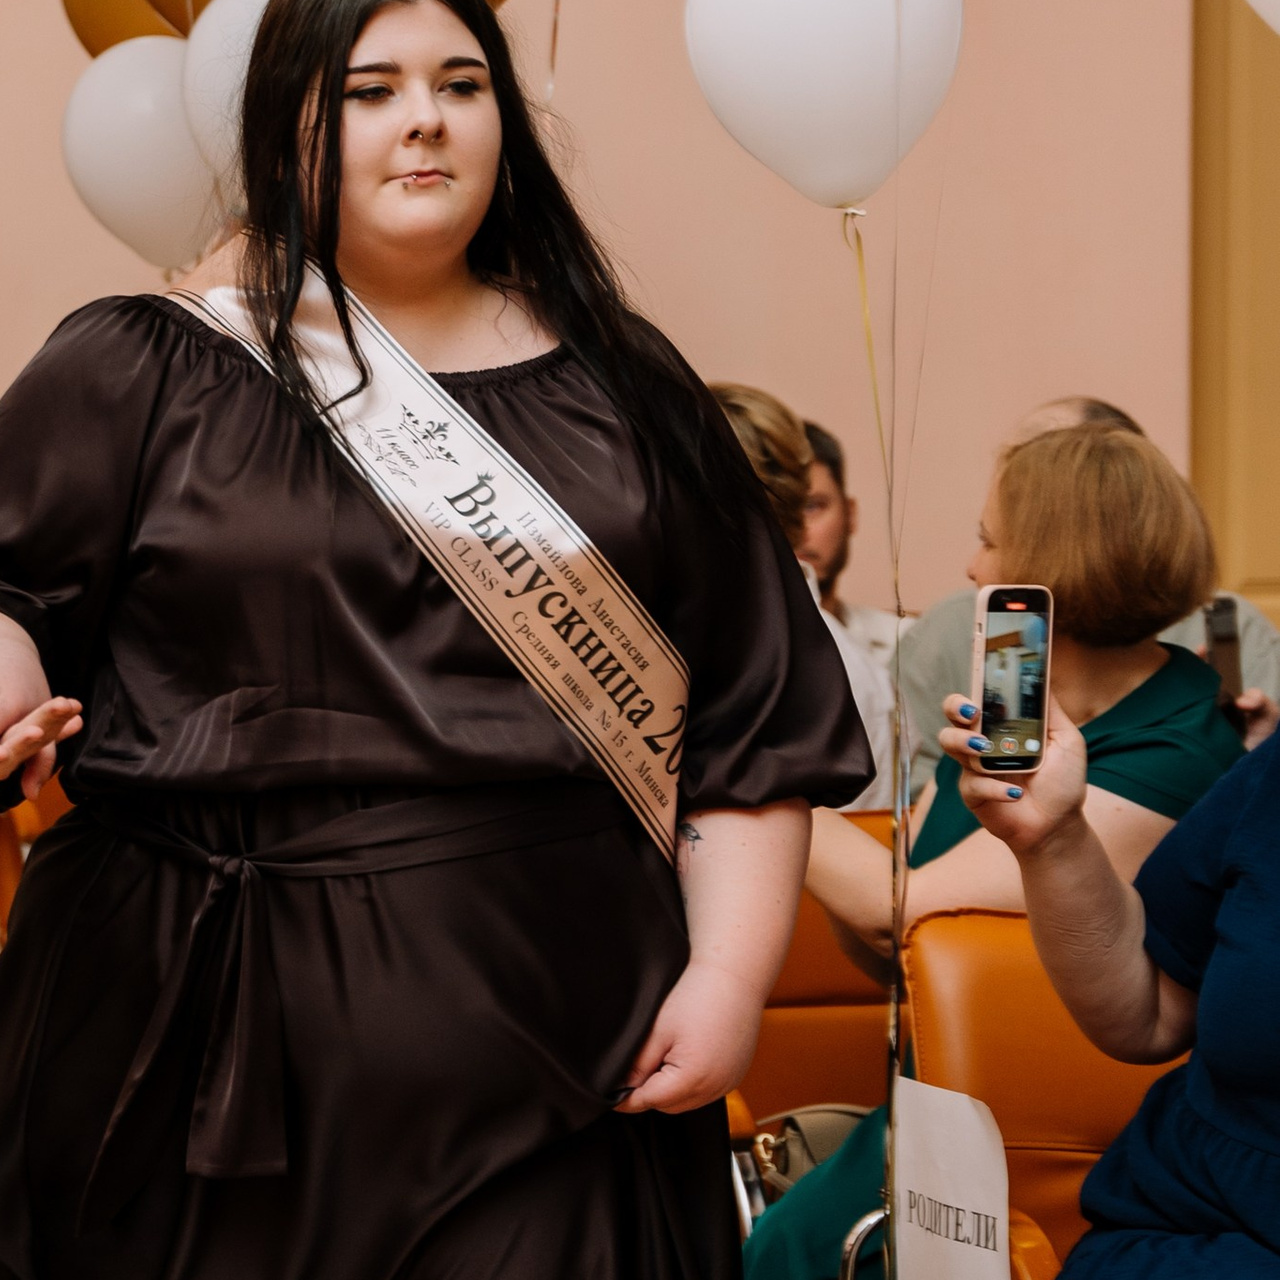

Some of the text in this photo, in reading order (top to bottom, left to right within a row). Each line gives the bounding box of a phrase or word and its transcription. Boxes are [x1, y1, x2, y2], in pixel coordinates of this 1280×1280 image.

[423, 501, 499, 592] VIP CLASS
[516, 511, 651, 672] Измайлова Анастасия
[512, 611, 562, 671] Средняя
[561, 672, 595, 711] школа
[595, 709, 613, 731] №
[611, 730, 628, 748] 15
[634, 760, 670, 808] Минска
[907, 1189, 999, 1252] РОДИТЕЛИ
